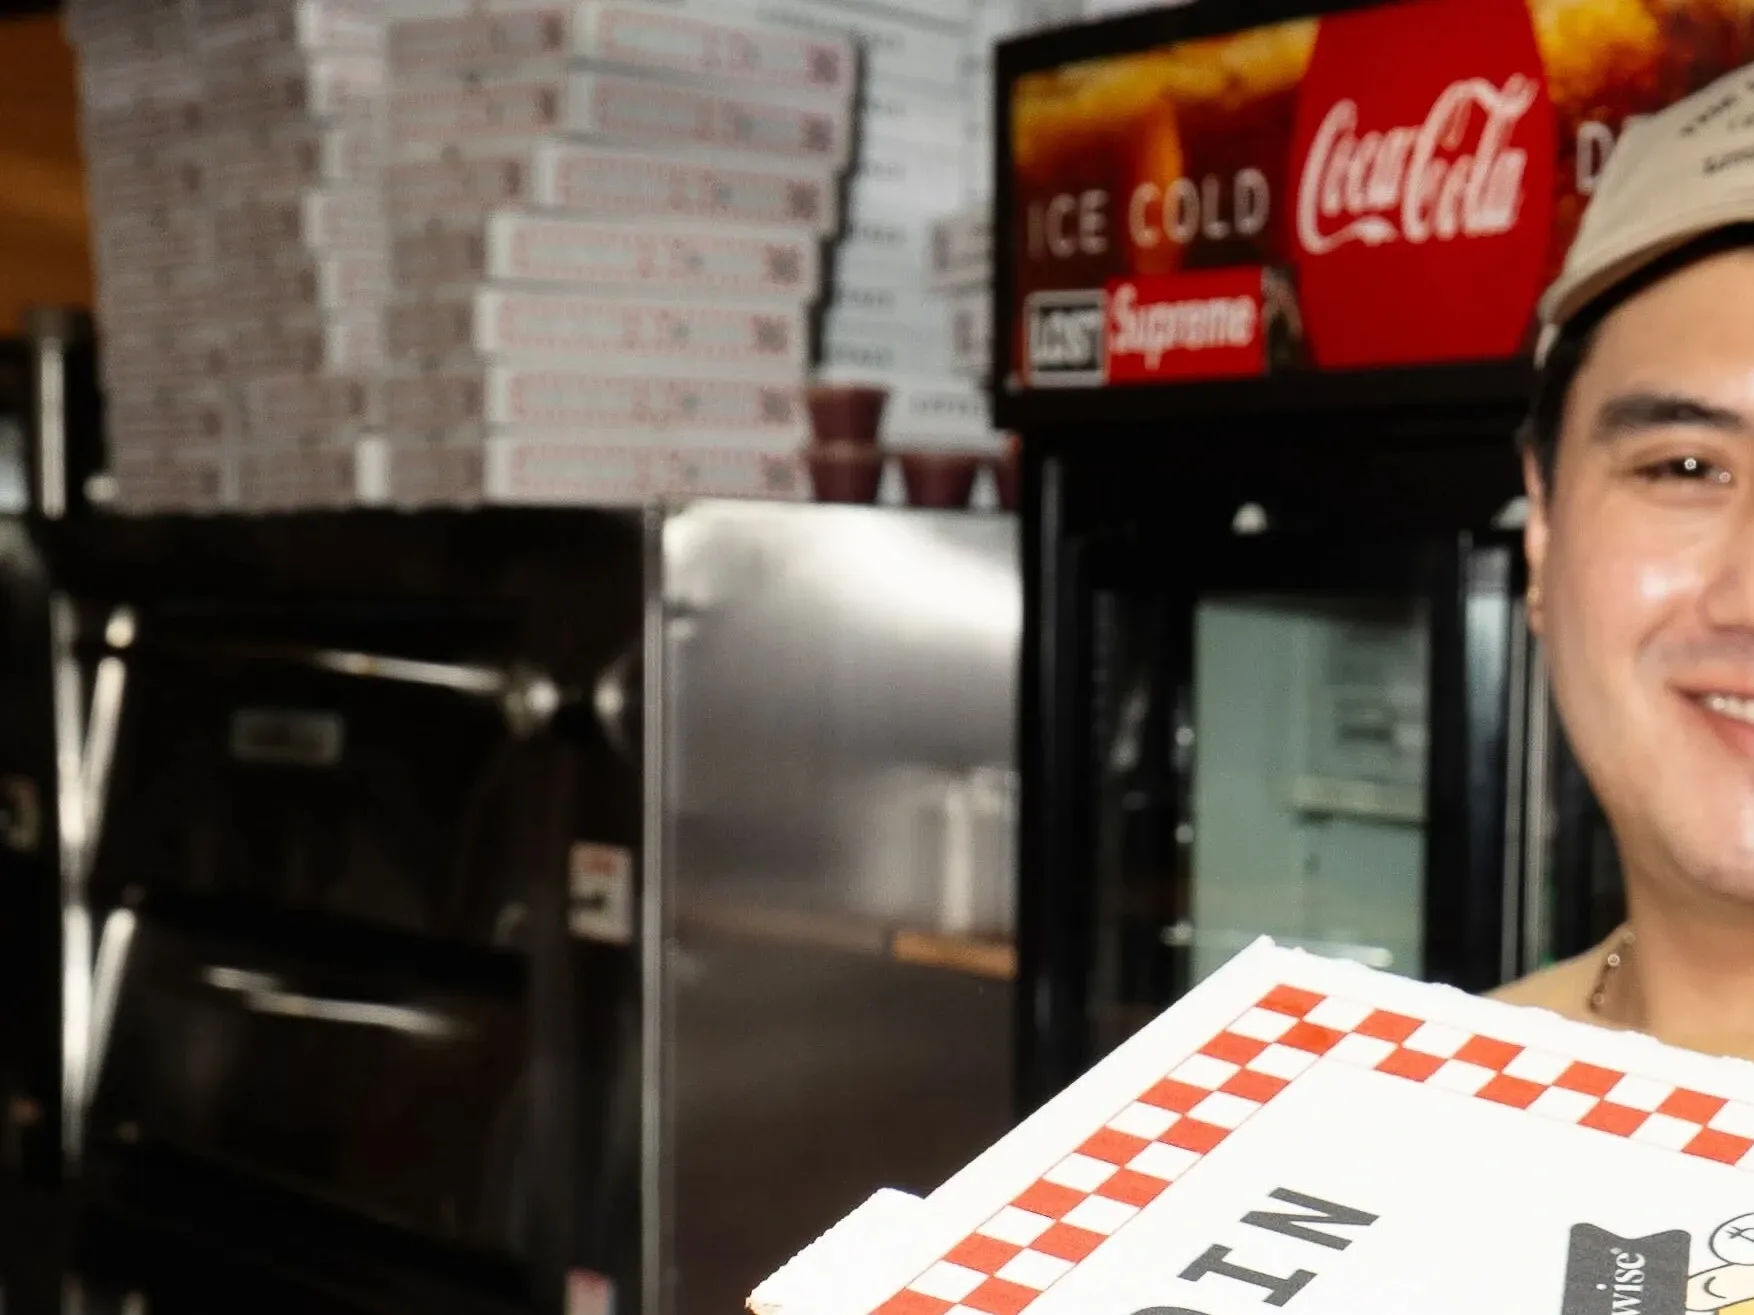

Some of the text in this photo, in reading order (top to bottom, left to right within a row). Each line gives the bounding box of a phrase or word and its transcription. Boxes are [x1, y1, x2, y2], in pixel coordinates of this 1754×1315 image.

[1024, 168, 1270, 260] ICE COLD
[1111, 284, 1256, 371] Supreme
